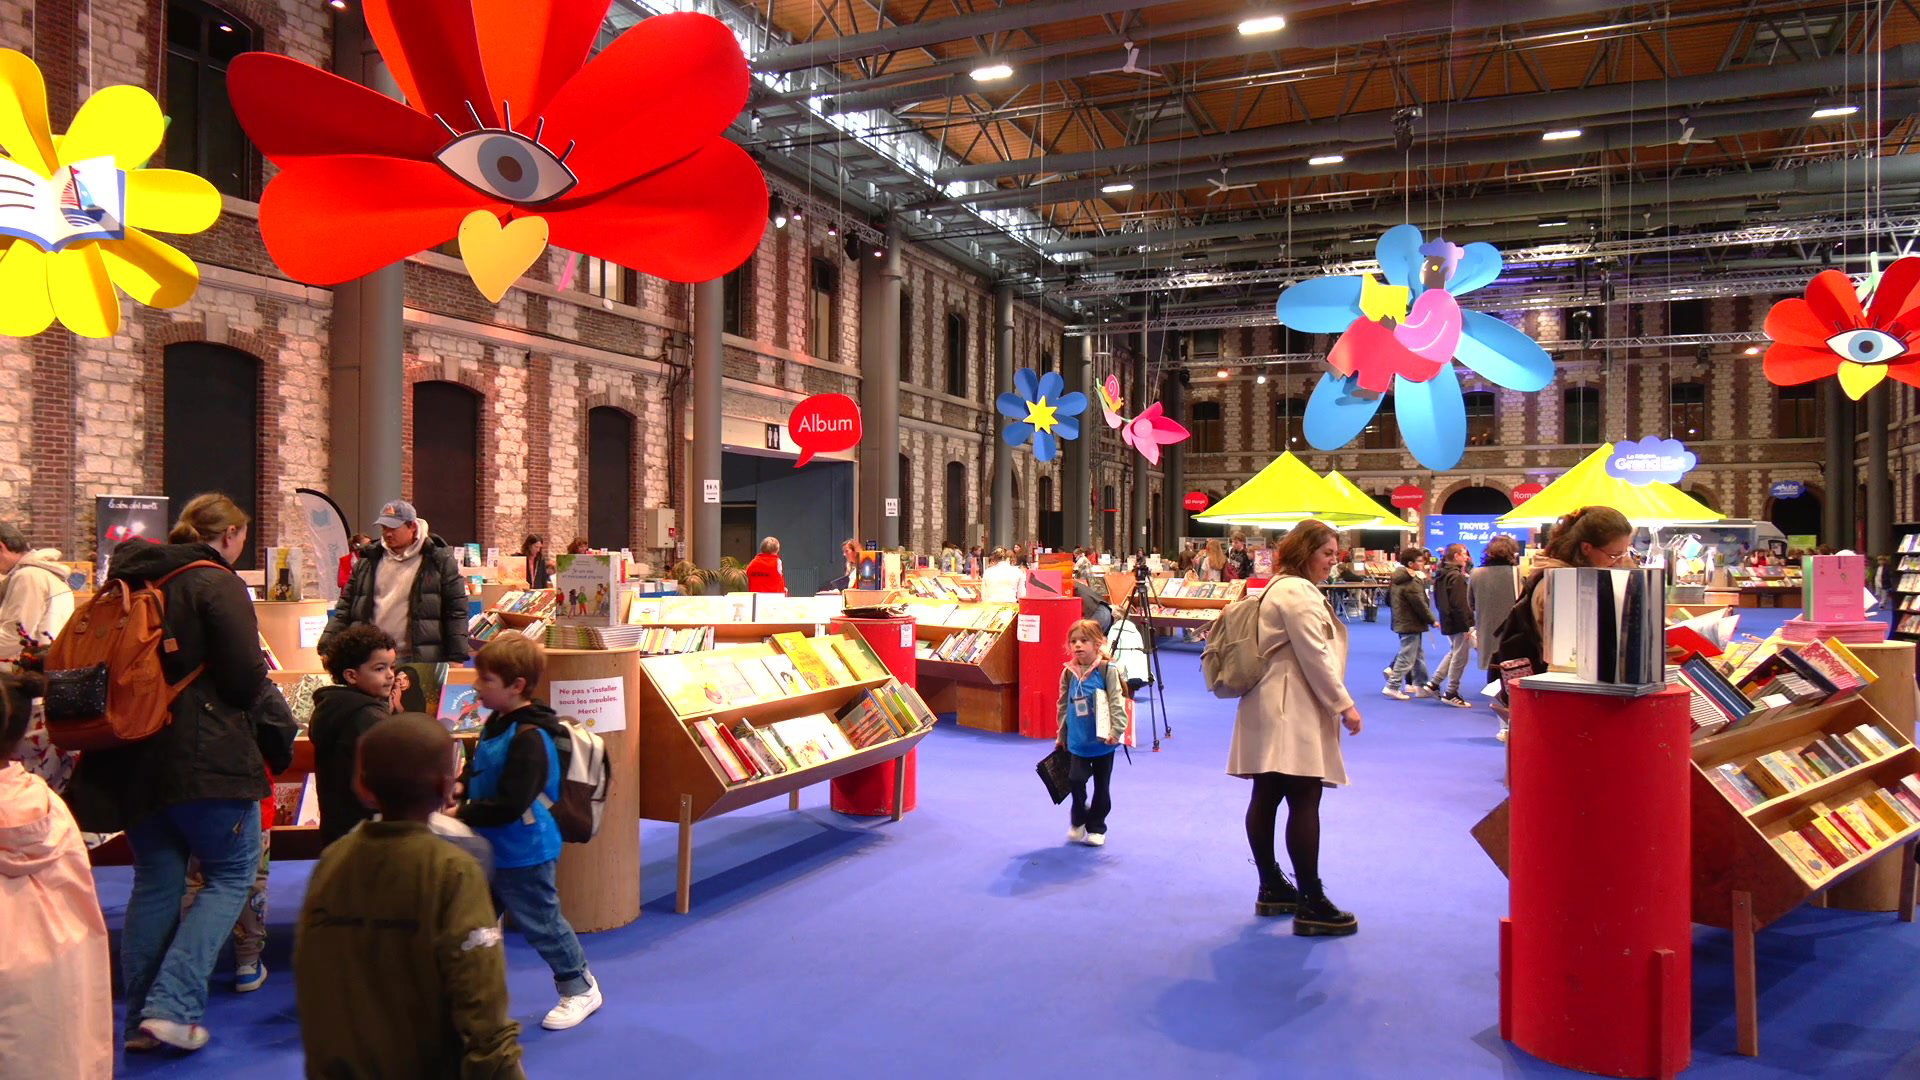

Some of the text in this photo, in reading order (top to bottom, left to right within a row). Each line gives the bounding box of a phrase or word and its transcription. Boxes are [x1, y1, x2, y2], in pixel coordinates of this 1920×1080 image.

[798, 413, 853, 432] Album
[1458, 522, 1489, 531] TROYES
[586, 685, 617, 694] s'installer
[589, 695, 617, 704] meubles.
